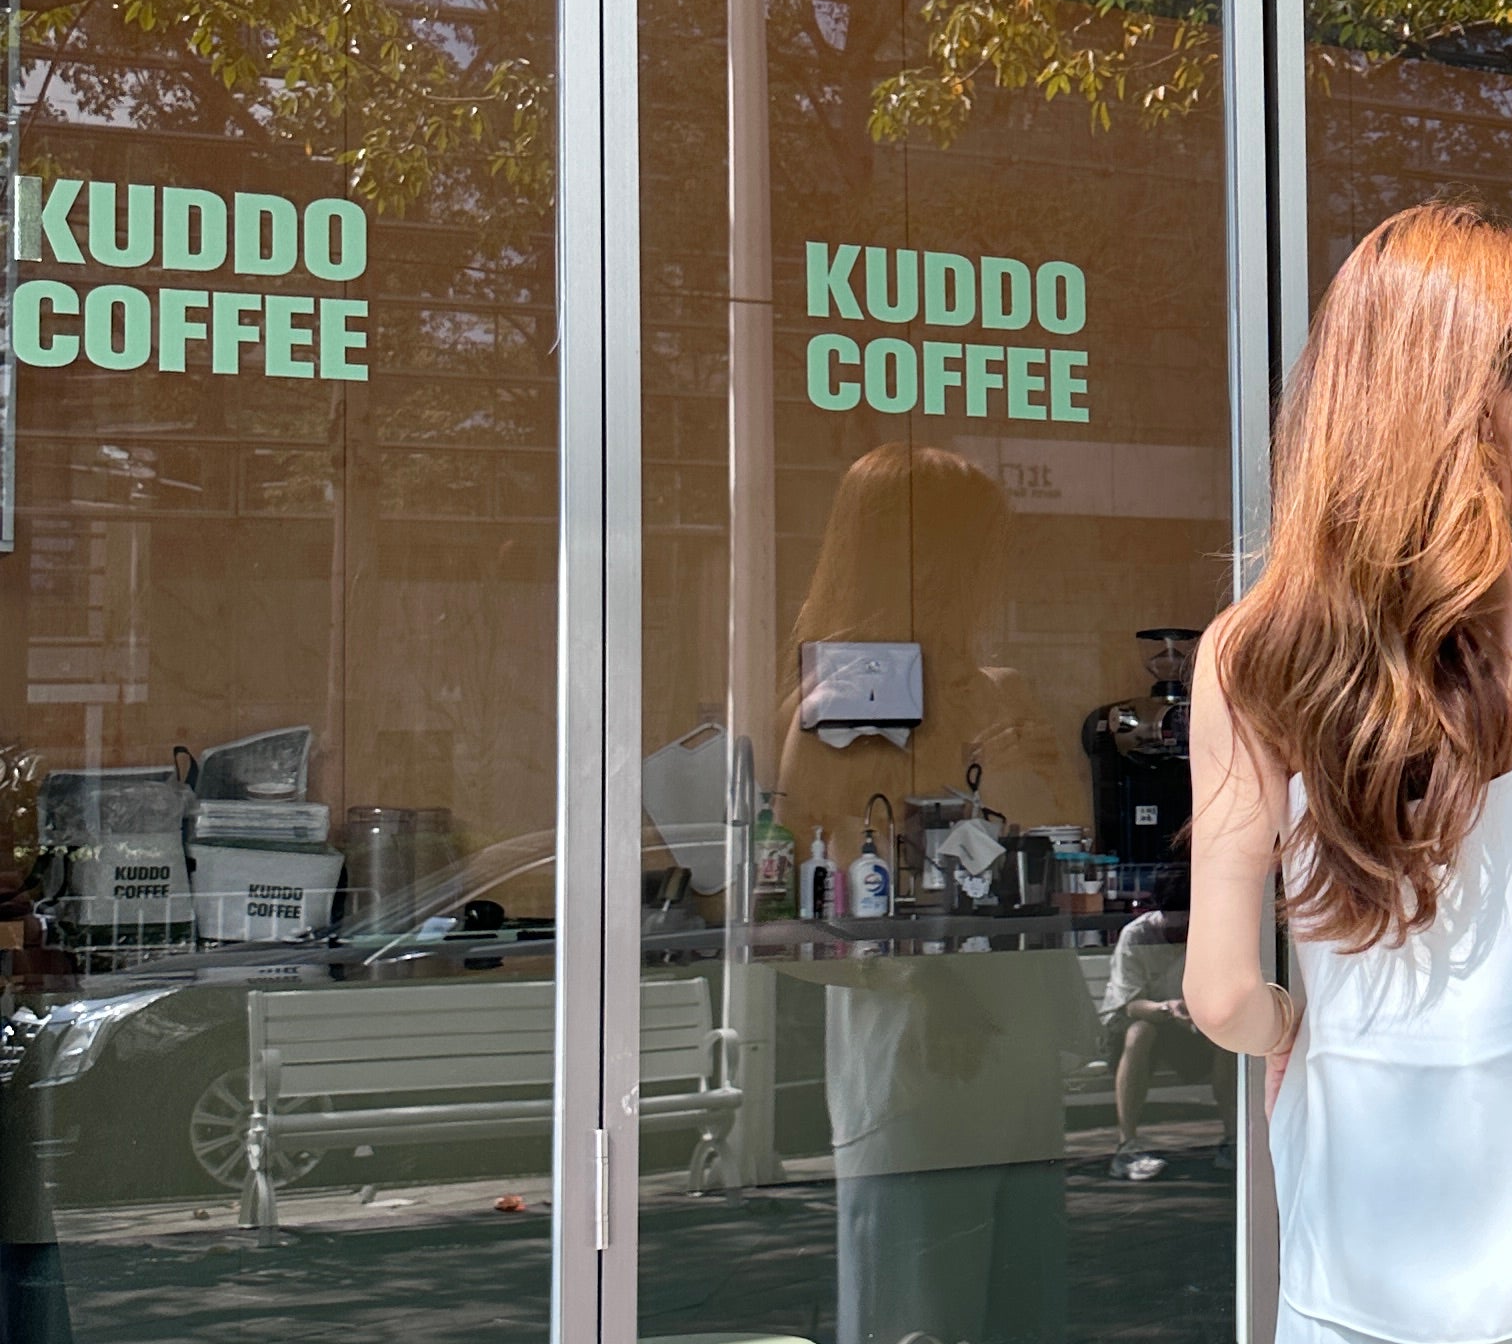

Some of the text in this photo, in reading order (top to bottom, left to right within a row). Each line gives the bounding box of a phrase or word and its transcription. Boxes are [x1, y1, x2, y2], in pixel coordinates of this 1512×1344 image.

[14, 175, 367, 281] KUDDO
[806, 241, 1087, 335] KUDDO
[13, 281, 368, 381] COFFEE
[807, 335, 1090, 423] COFFEE
[114, 866, 171, 881] KUDDO
[114, 884, 170, 899] COFFEE
[248, 884, 303, 901] KUDDO
[247, 902, 302, 919] COFFEE
